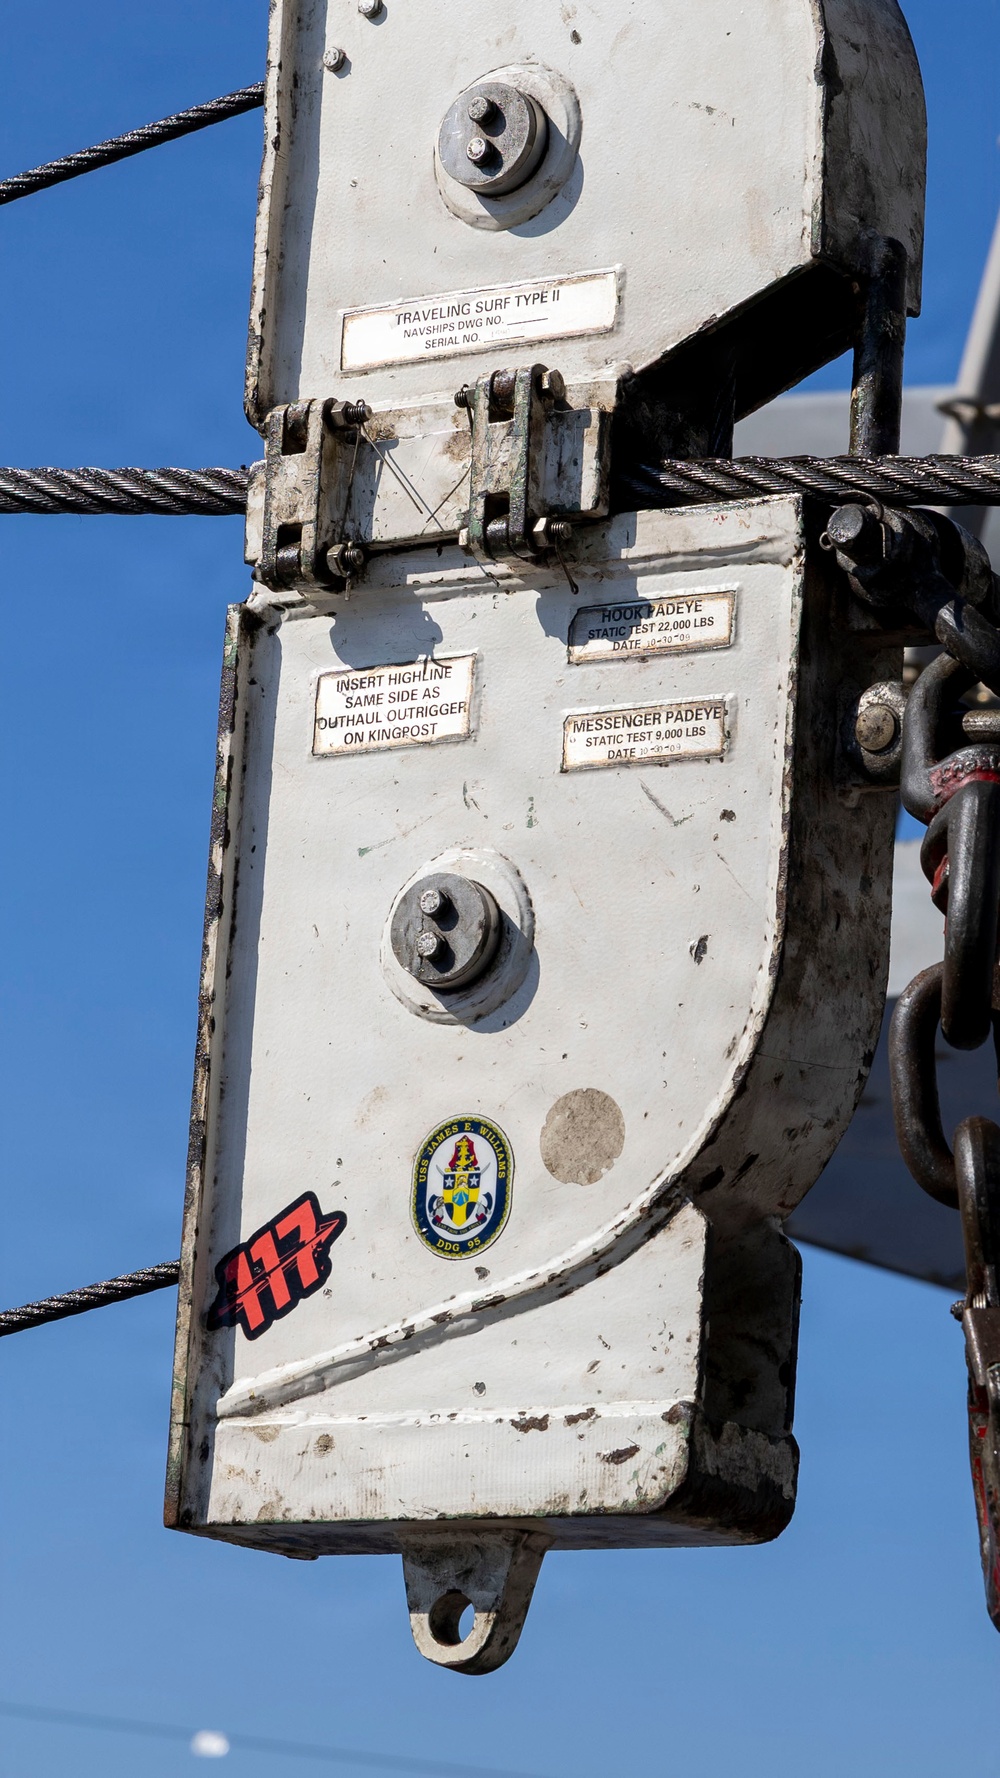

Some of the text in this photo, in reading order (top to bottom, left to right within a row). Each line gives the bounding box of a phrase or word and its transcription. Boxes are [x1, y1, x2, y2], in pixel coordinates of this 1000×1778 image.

[395, 289, 560, 326] TRAVELING SURF TYPE II
[403, 316, 505, 338] NAVSHIPS DWG NO.
[424, 334, 460, 350] SERIAL
[463, 332, 481, 344] NO.
[602, 600, 703, 623] HOOK PADEYE
[588, 616, 715, 640] STATIC TEST 22,000 LBS
[613, 639, 641, 651] DATE
[336, 667, 452, 692] INSERT HIGHLINE
[345, 686, 440, 709] SAME SIDE AS
[317, 701, 467, 730] OUTHAUL OUTRIGGER
[573, 706, 722, 734] MESSENGER PADEYE
[344, 723, 438, 745] ON KINGPOST
[585, 726, 706, 747] STATIC TEST 9,000 LBS
[607, 748, 636, 760] DATE
[419, 1122, 506, 1182] USS JAMES E. WILLIAMS
[436, 1237, 481, 1252] DDG 95
